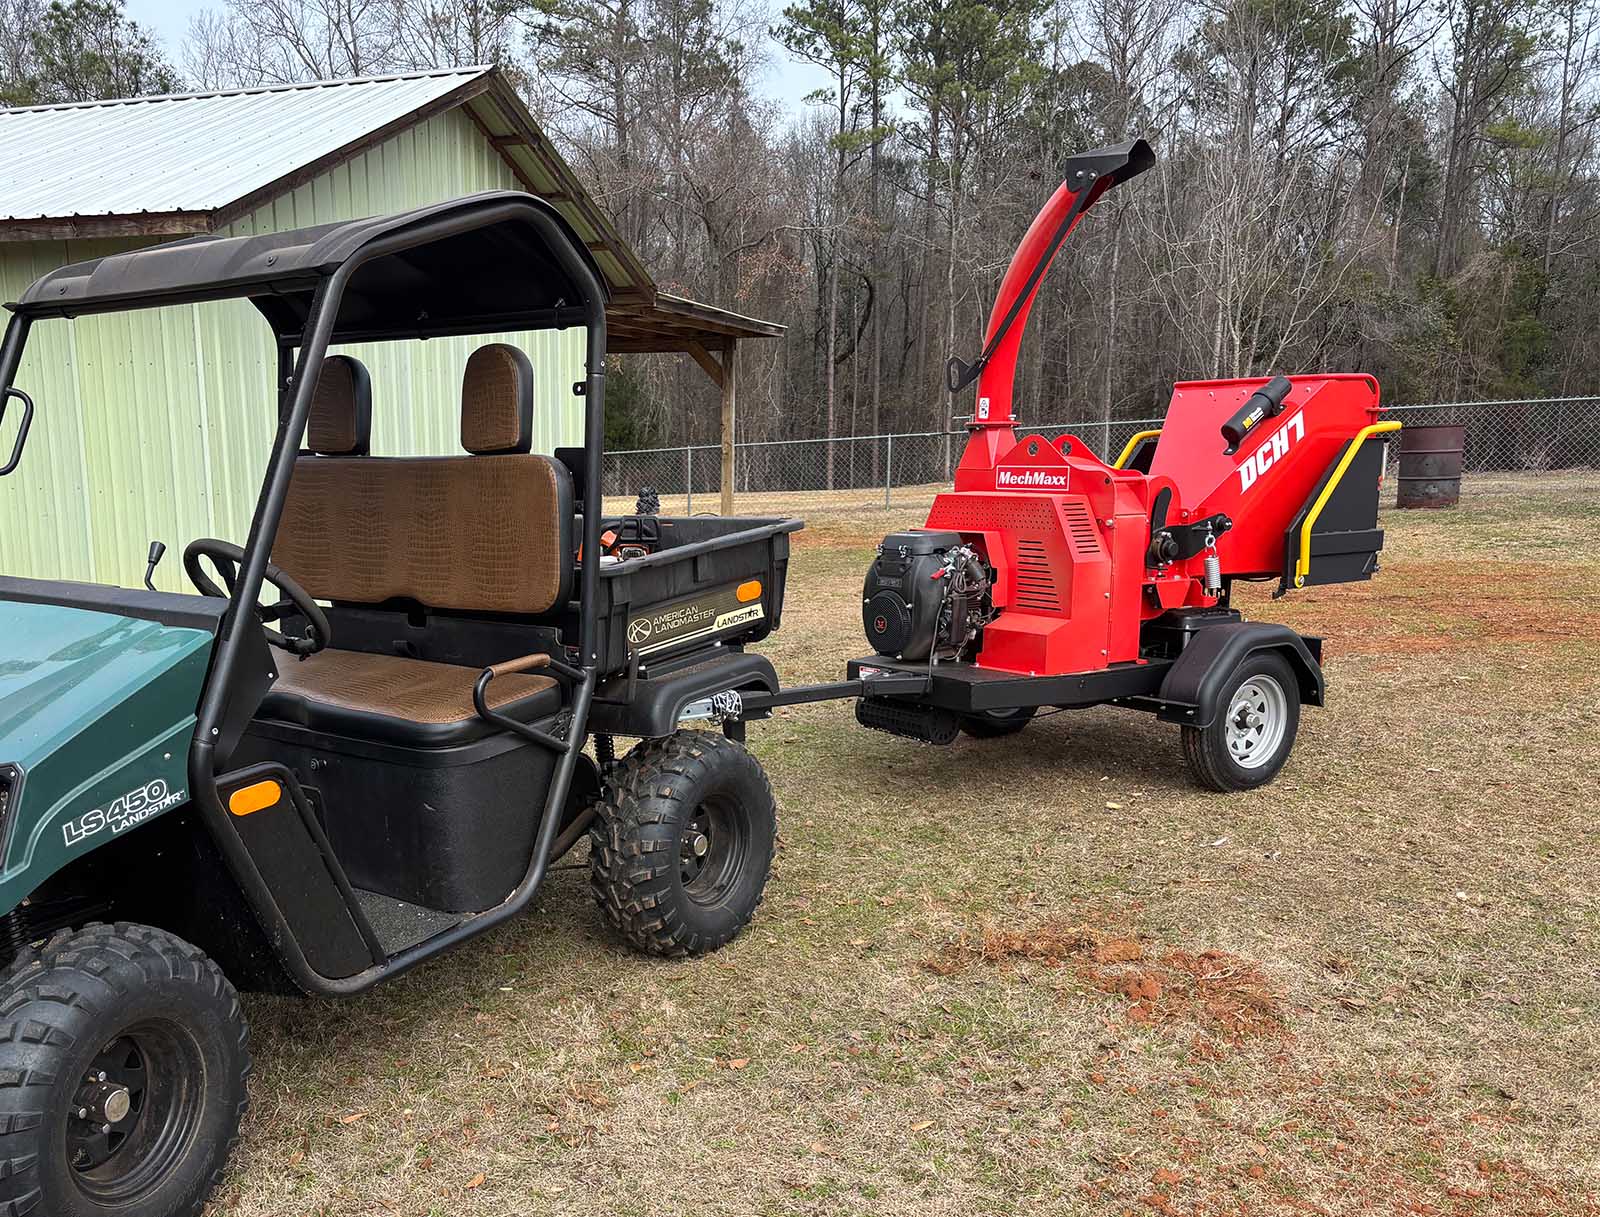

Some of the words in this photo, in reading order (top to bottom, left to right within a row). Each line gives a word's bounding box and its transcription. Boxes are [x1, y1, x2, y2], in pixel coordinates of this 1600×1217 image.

[1236, 410, 1305, 495] DCH7
[998, 471, 1066, 486] MechMaxx
[653, 605, 699, 627] AMERICAN
[655, 609, 715, 634] LANDMASTER
[62, 809, 106, 847] LS
[106, 779, 168, 822] 450
[112, 793, 182, 834] LANDSTAR
